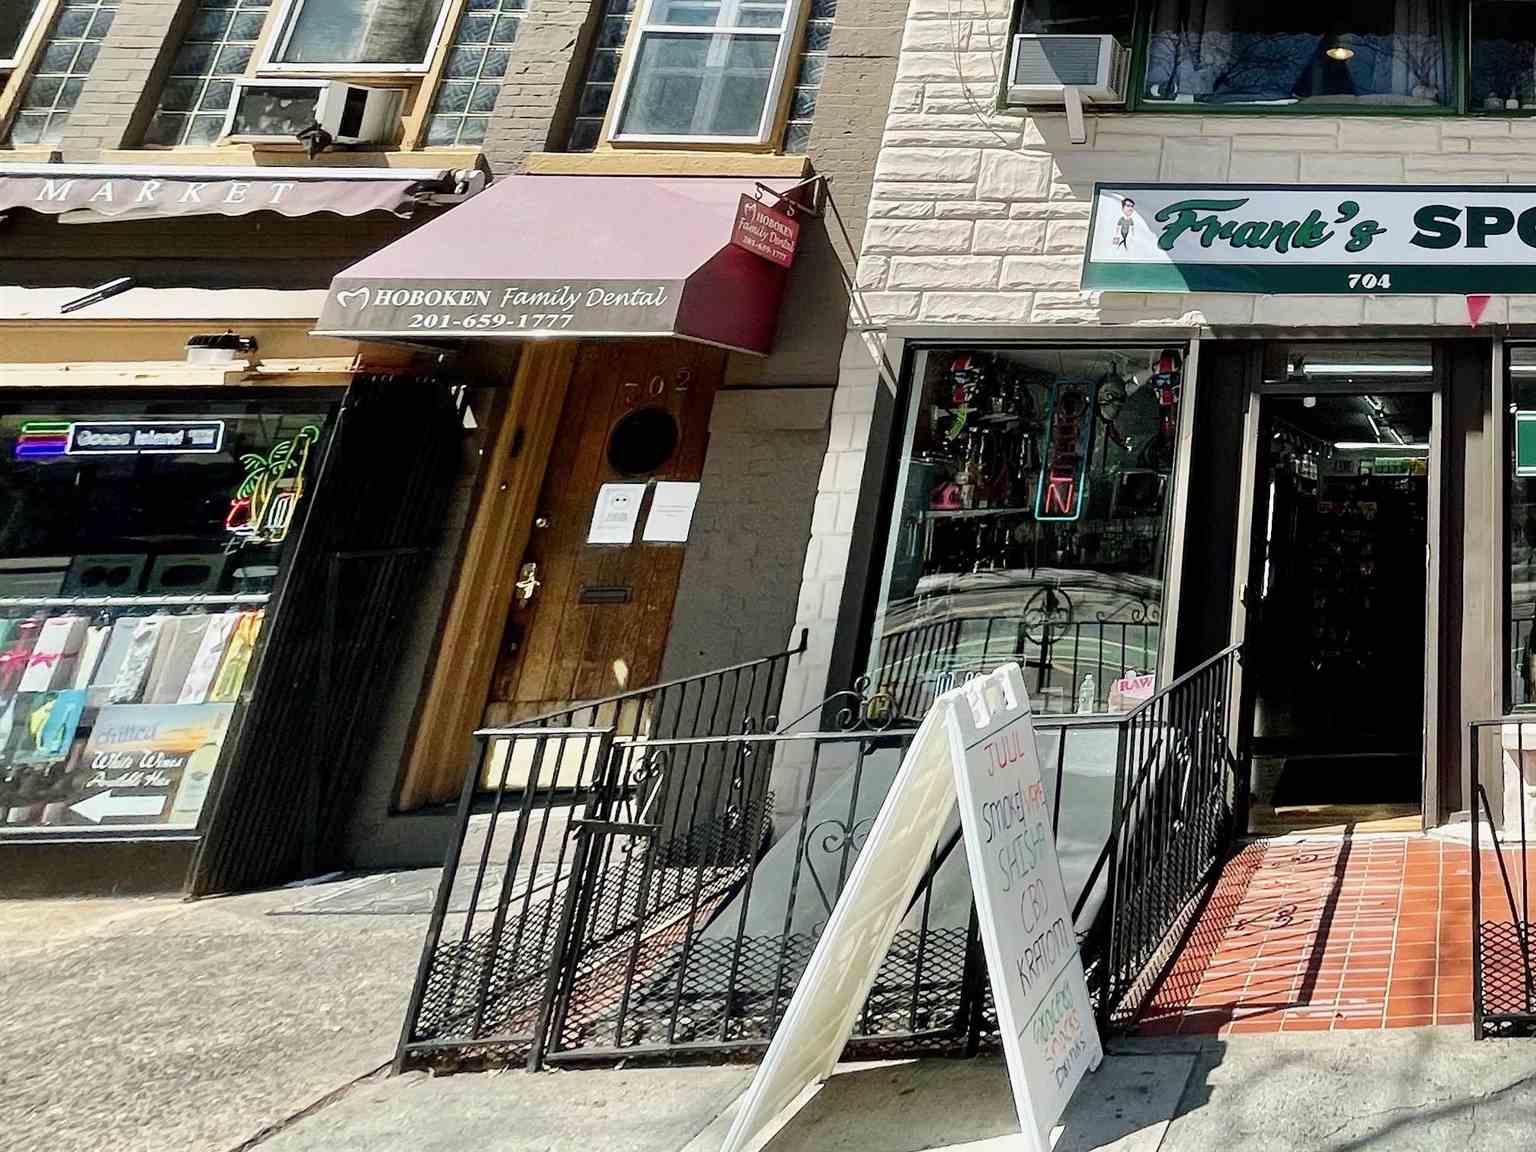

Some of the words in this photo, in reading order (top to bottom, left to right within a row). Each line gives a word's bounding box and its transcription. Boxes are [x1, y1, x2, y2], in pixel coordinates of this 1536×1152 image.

[36, 179, 294, 204] MARKET
[756, 212, 794, 240] HOBOKEN
[1155, 198, 1388, 253] Frank's
[1347, 272, 1393, 290] 704
[373, 289, 492, 307] HOBOKEN
[500, 286, 582, 310] Family
[585, 286, 667, 308] Dental
[408, 313, 575, 329] 201-659-1777
[624, 367, 692, 406] 702
[1118, 677, 1153, 692] RAW
[983, 728, 1025, 777] JUUL
[1020, 877, 1049, 934] CBD
[1016, 917, 1071, 997] KRATOM
